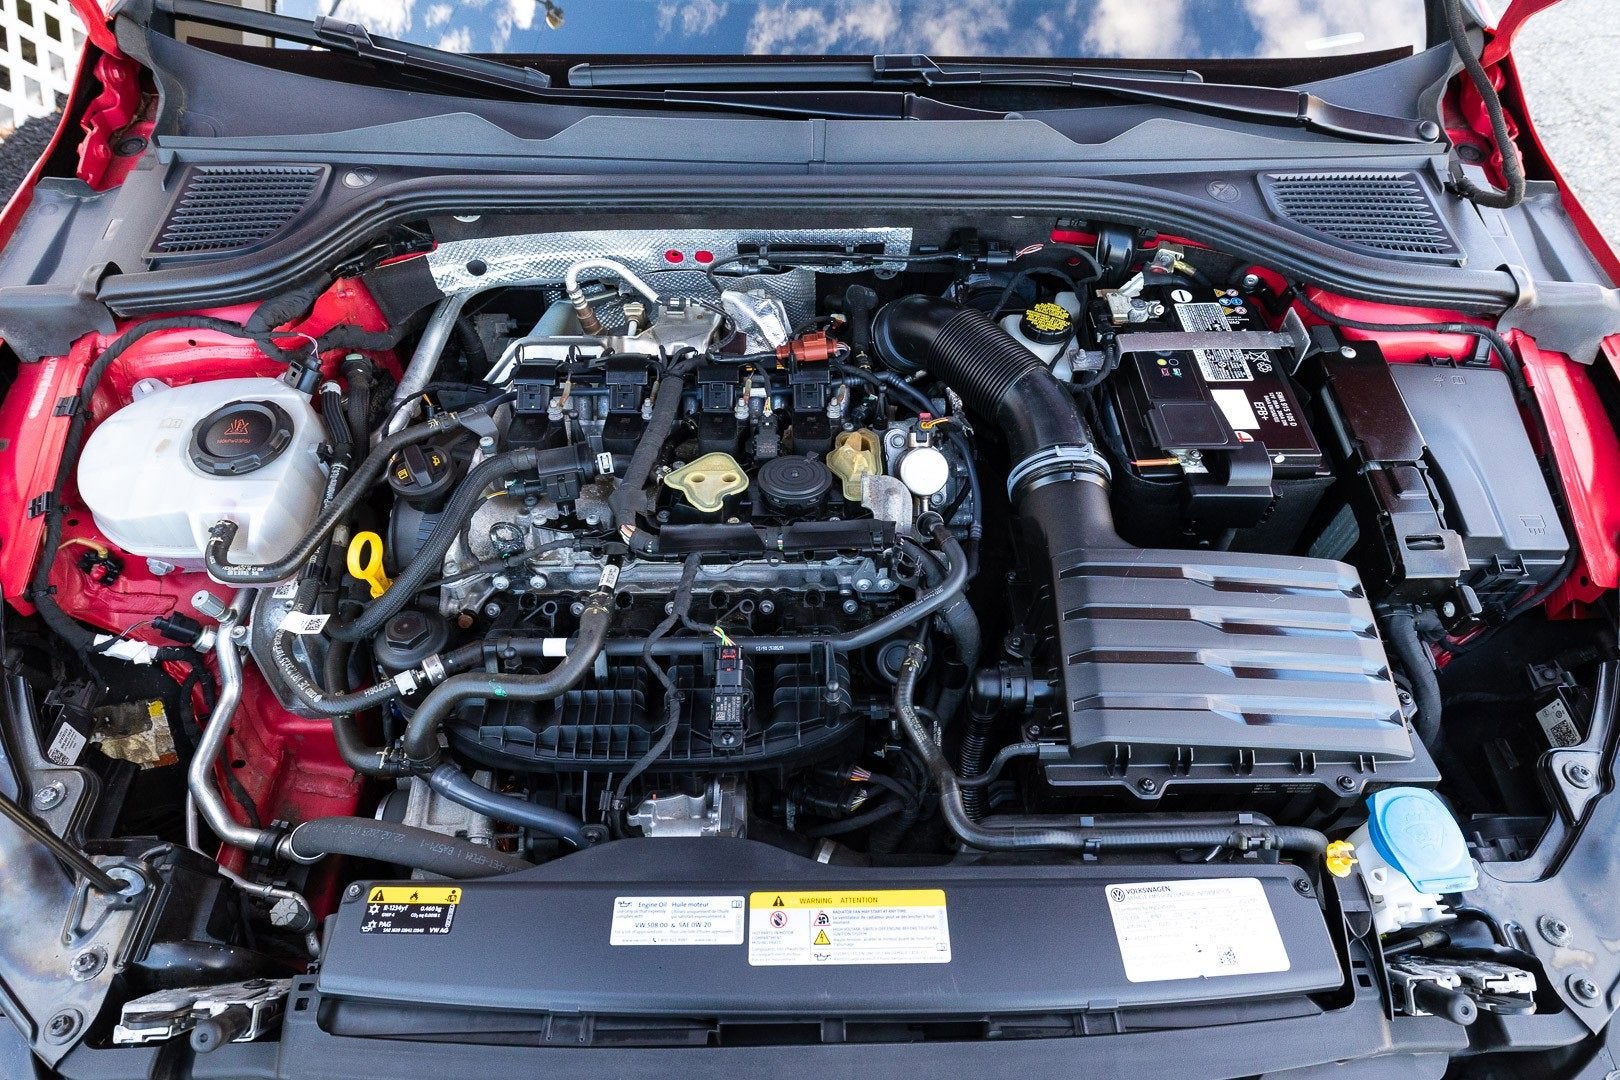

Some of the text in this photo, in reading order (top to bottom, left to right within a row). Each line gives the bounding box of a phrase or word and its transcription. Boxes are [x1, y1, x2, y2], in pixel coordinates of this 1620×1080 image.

[1254, 402, 1269, 421] EFB+
[1125, 886, 1171, 894] VOLKSWAGEN
[383, 904, 409, 912] R-1234yf
[638, 901, 658, 909] Engine
